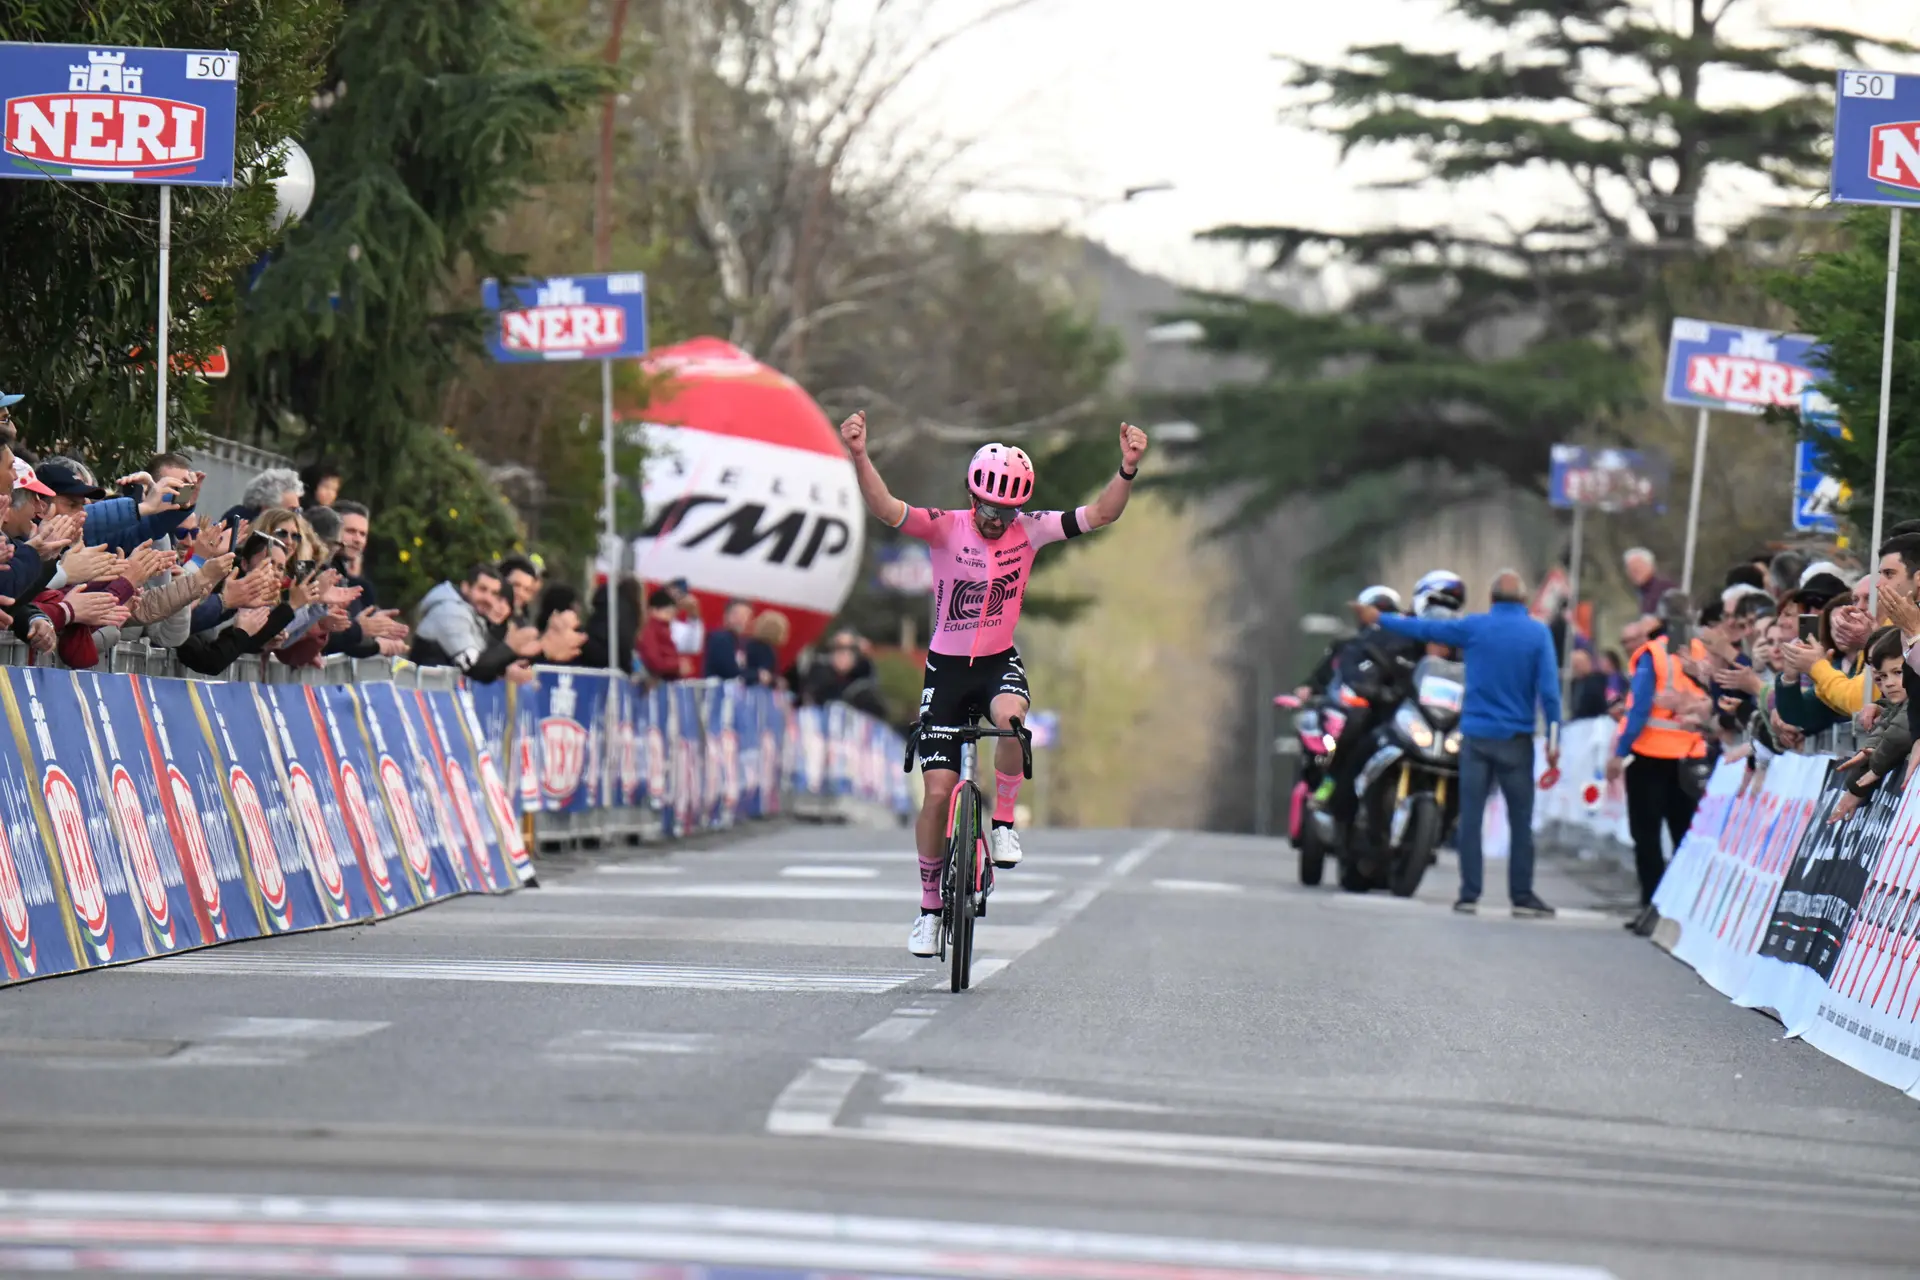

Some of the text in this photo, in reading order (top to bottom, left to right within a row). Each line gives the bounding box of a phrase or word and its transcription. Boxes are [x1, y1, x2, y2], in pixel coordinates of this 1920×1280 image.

[196, 56, 226, 78] 50
[1854, 75, 1884, 96] 50
[12, 98, 198, 161] NERI
[505, 306, 619, 347] NERI
[963, 559, 987, 569] NIPPO
[943, 618, 1002, 632] Education
[927, 732, 953, 741] NIPPO
